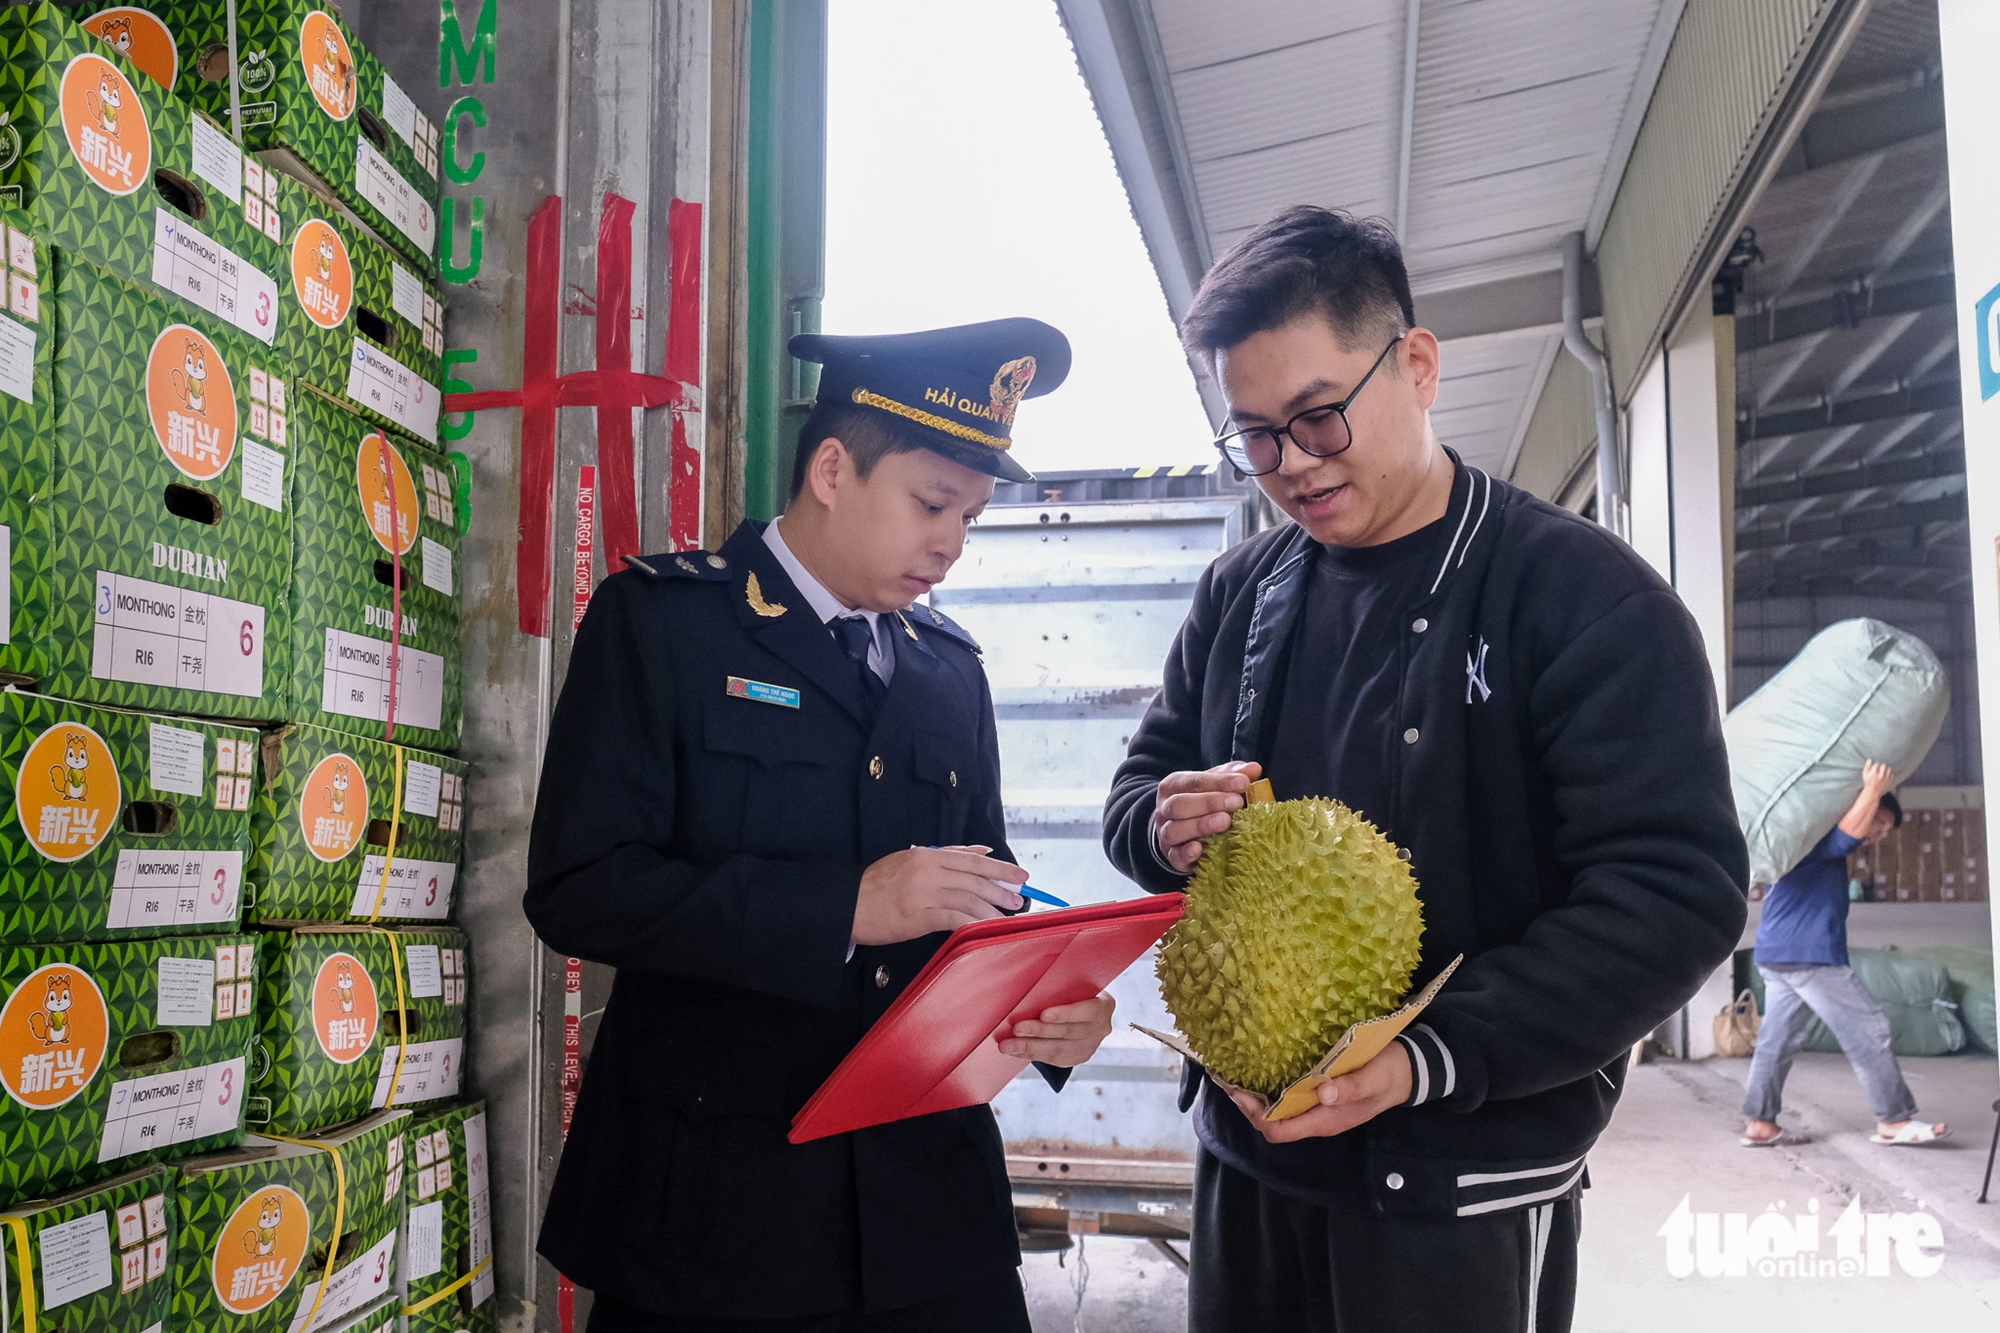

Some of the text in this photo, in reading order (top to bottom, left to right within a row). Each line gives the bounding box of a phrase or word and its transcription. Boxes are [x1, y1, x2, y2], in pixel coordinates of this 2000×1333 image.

[246, 67, 267, 79] 100%
[312, 63, 345, 115] 新兴
[80, 125, 133, 188] 新兴
[370, 156, 395, 186] MONTHONG
[418, 202, 428, 231] 3
[176, 231, 237, 278] MONTHONG 金枕
[187, 275, 202, 292] RI6
[304, 275, 340, 321] 新兴
[255, 291, 271, 327] 3
[366, 354, 395, 378] MONTHONG
[414, 376, 424, 404] 3
[167, 410, 221, 468] 新兴
[579, 487, 592, 504] NO
[577, 509, 592, 546] CARGO
[152, 541, 228, 583] DURIAN
[575, 551, 590, 595] BEYOND
[98, 585, 112, 615] 3
[117, 594, 206, 626] MONTHONG 金枕
[364, 604, 418, 637] DURAN
[240, 620, 254, 656] 6
[135, 649, 202, 675] RI6 干尧
[339, 646, 380, 665] MONTHONG
[38, 805, 100, 845] 新兴
[312, 817, 354, 850] 新兴
[137, 861, 201, 876] MONTHONG 金枕
[376, 867, 404, 878] MOHONG
[210, 868, 226, 905] 3
[425, 876, 438, 907] 3
[145, 900, 159, 913] RI6
[566, 971, 580, 993] BEY
[328, 1017, 367, 1051] 新兴
[565, 1022, 579, 1046] THIS
[20, 1047, 86, 1095] 新兴
[441, 1053, 451, 1084] 3
[132, 1079, 204, 1104] MONTHONG 金枕
[218, 1067, 233, 1105] 3
[140, 1123, 156, 1138] RI6
[228, 1257, 287, 1302] 新兴
[373, 1250, 386, 1283] 3
